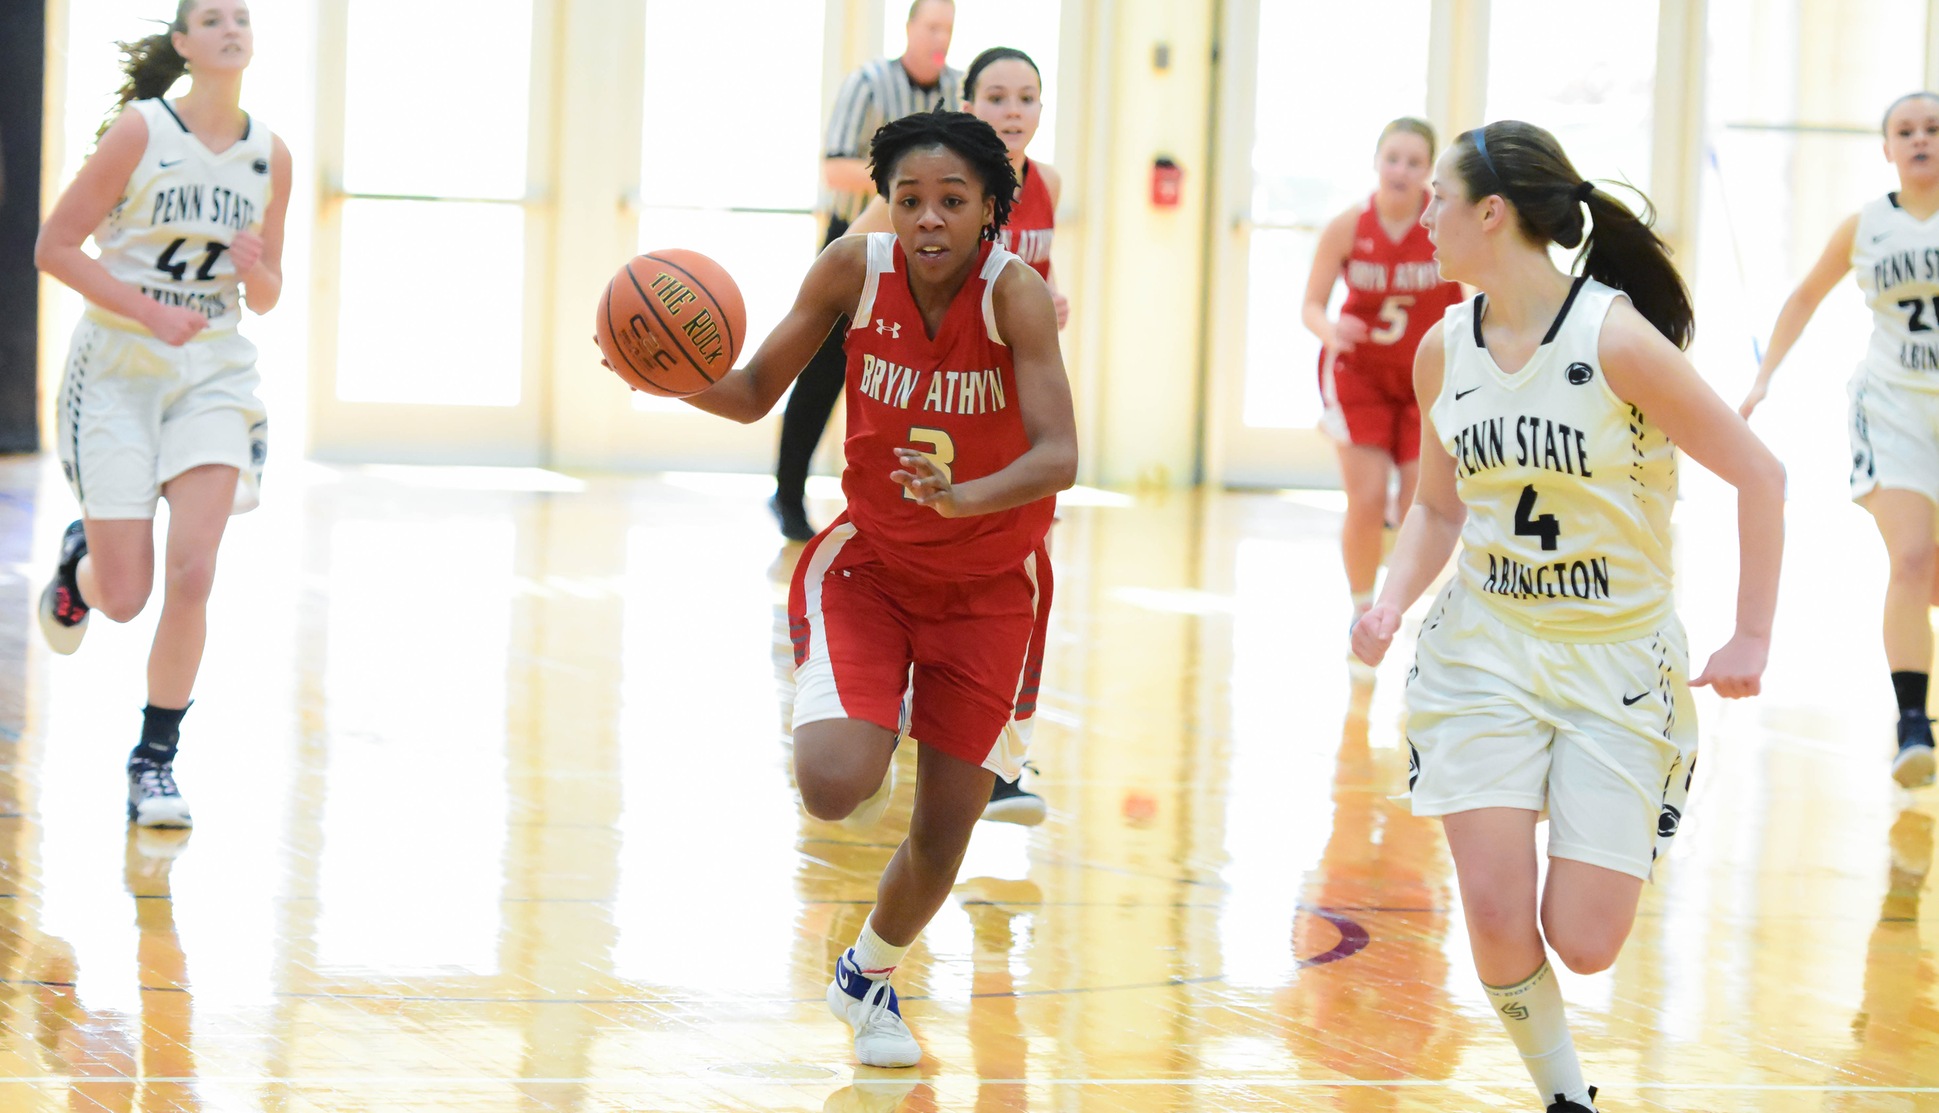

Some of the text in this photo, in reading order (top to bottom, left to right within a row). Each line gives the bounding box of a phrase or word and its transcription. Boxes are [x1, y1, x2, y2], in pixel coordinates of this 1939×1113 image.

[151, 184, 205, 225] PENN
[1874, 250, 1916, 293] PENN
[649, 271, 724, 365] THE ROCK
[1370, 294, 1416, 345] 5
[859, 353, 1006, 415] BRYN ATHYN
[903, 426, 955, 501] 3
[1516, 415, 1593, 478] STATE
[1514, 483, 1561, 551] 4
[1483, 552, 1611, 600] ABINGTON
